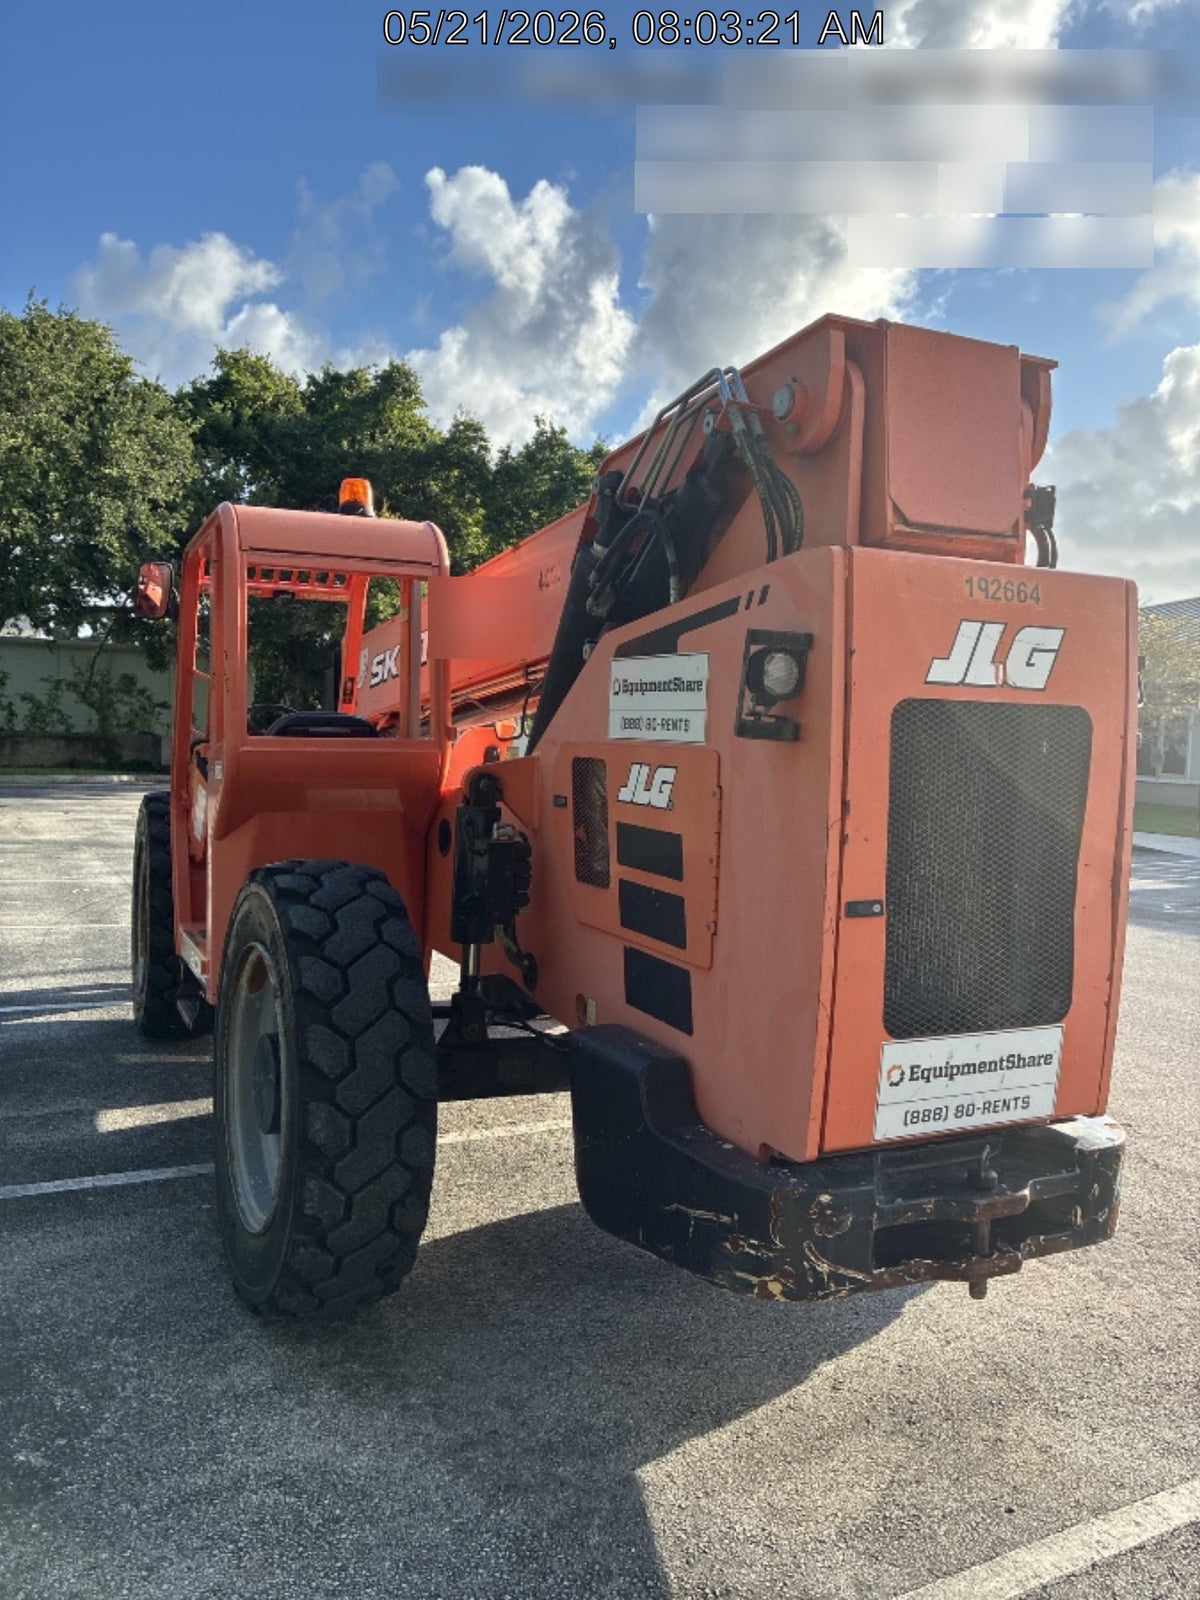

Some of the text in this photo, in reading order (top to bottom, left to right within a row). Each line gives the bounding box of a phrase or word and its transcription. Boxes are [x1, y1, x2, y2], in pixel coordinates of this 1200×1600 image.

[965, 576, 1041, 604] 192664
[924, 618, 1068, 691] JLG
[622, 676, 703, 696] EquipmentShare
[620, 716, 690, 732] (888) 80-RENTS
[617, 763, 677, 809] JLG
[908, 1053, 1053, 1082] EquipmentShare
[904, 1095, 1031, 1127] (888) 80-RENTS
